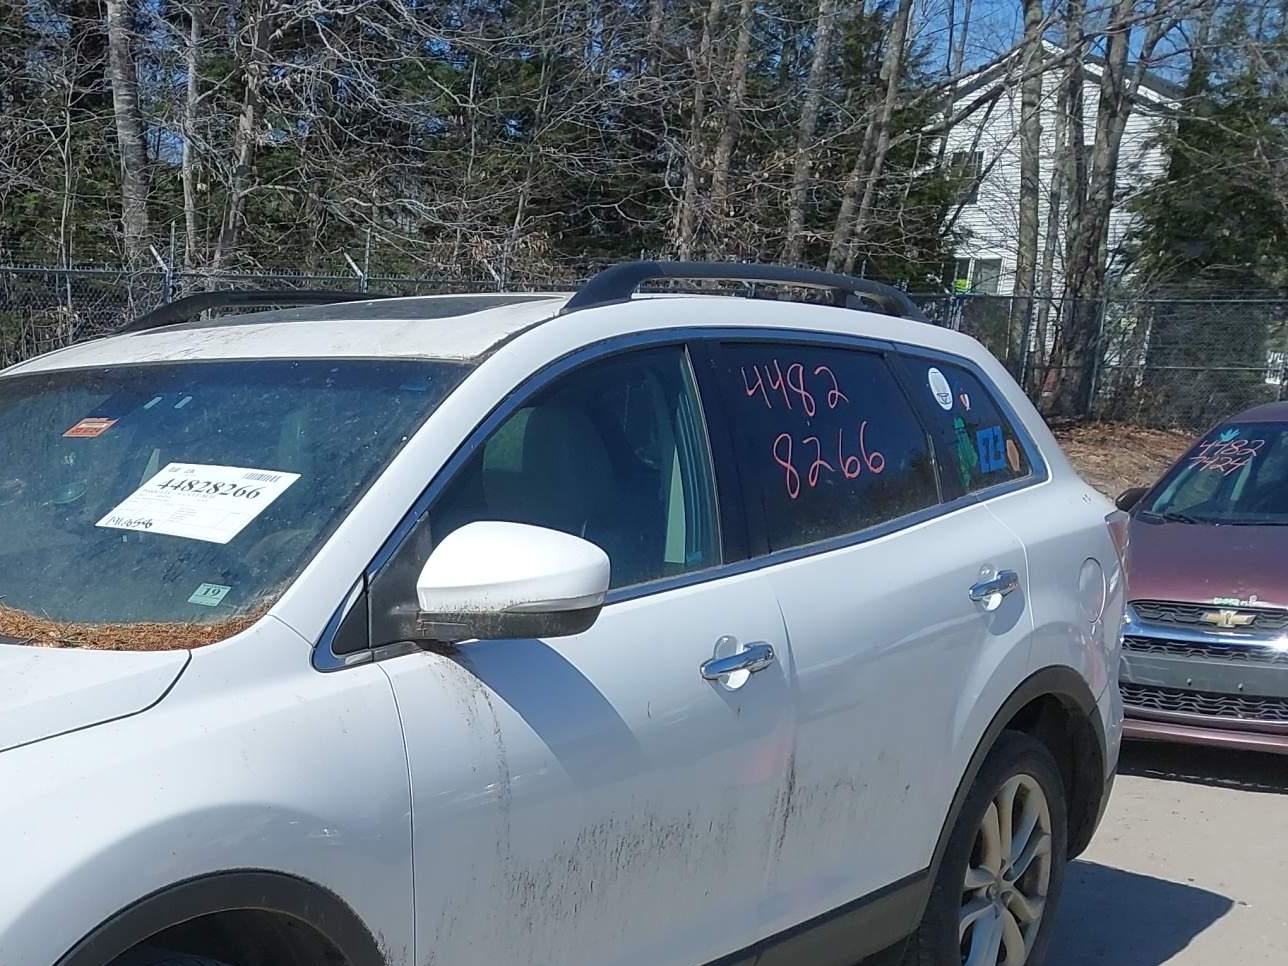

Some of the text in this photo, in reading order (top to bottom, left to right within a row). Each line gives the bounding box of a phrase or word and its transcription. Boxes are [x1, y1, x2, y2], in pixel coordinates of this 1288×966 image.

[741, 359, 849, 417] 4482
[773, 420, 886, 499] 8266
[1199, 439, 1265, 457] 4482
[155, 477, 266, 500] 44828266
